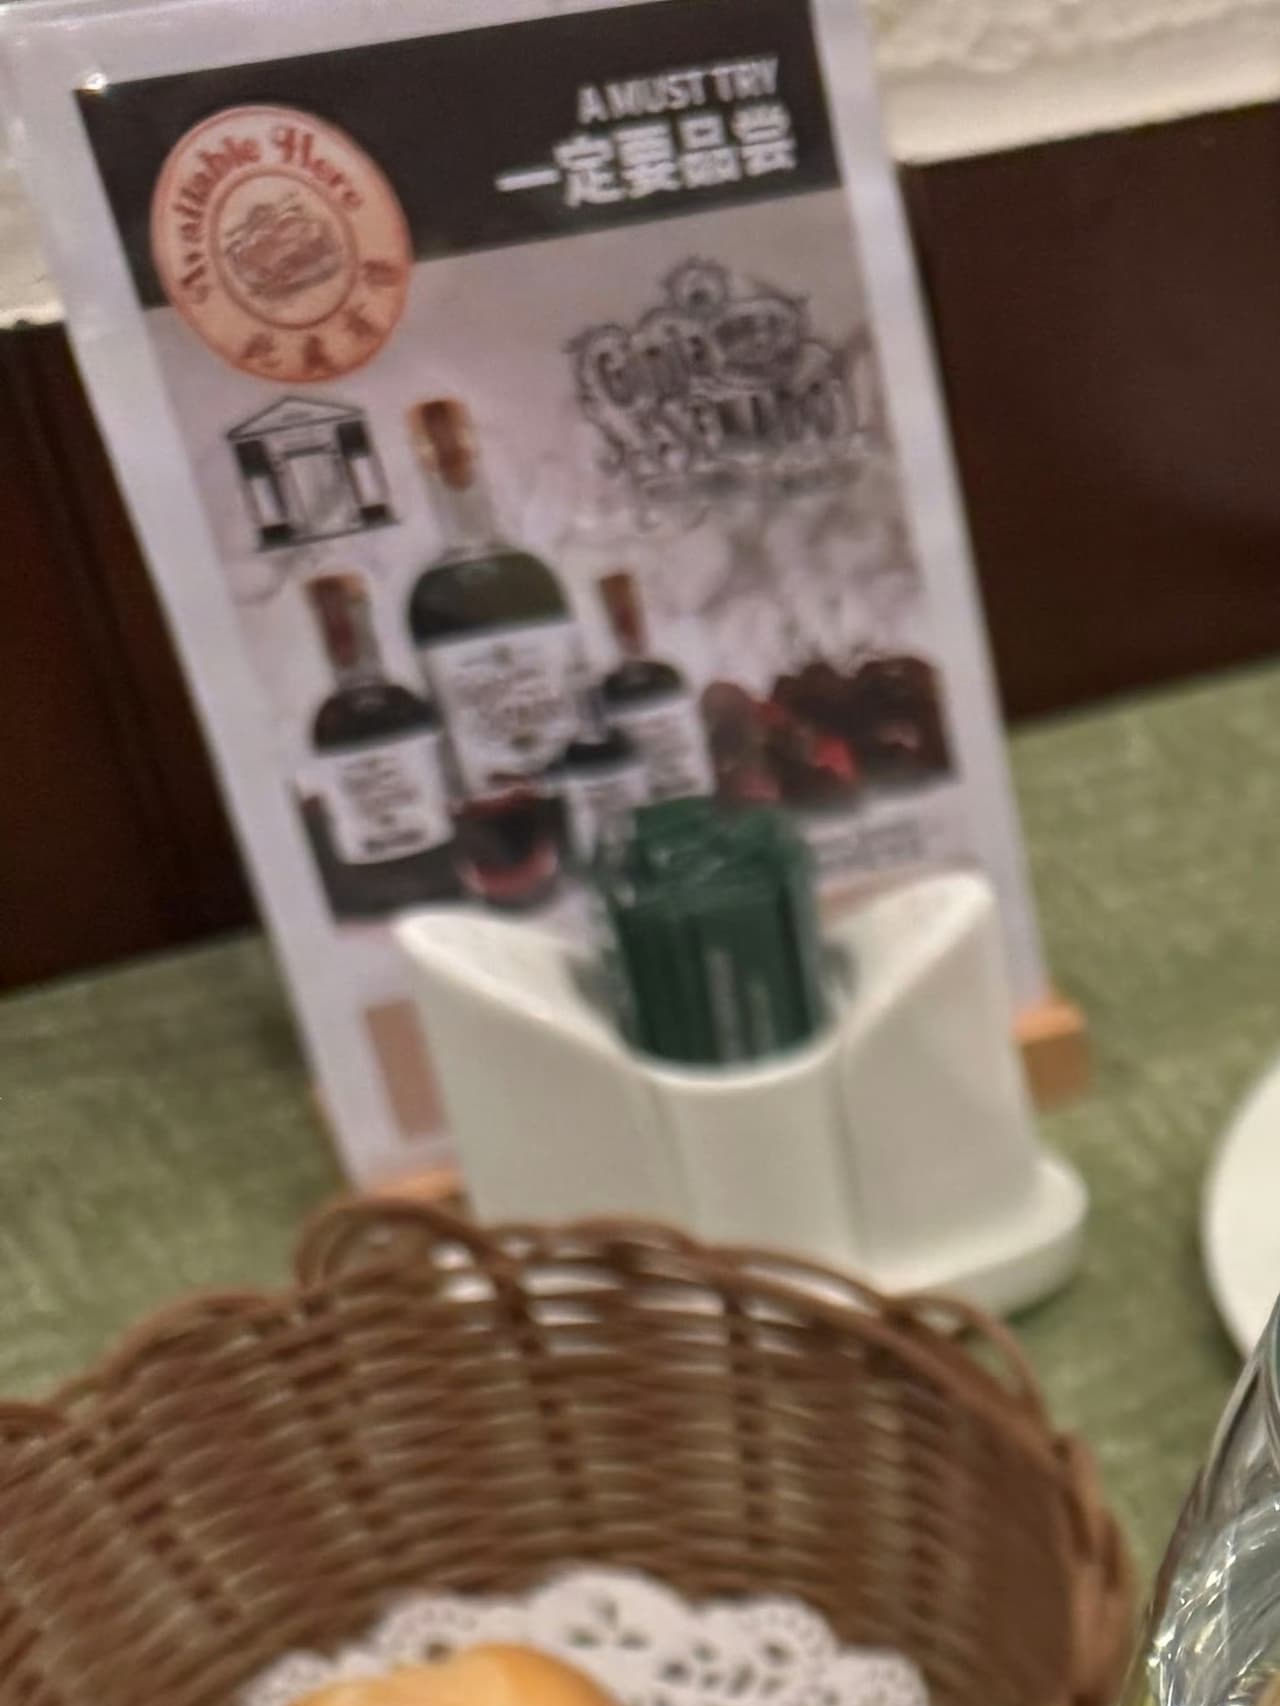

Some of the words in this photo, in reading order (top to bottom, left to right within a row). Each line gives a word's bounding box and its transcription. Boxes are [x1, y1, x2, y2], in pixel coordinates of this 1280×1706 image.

[577, 85, 608, 125] A
[604, 70, 706, 120] MUST
[710, 56, 778, 102] TRY
